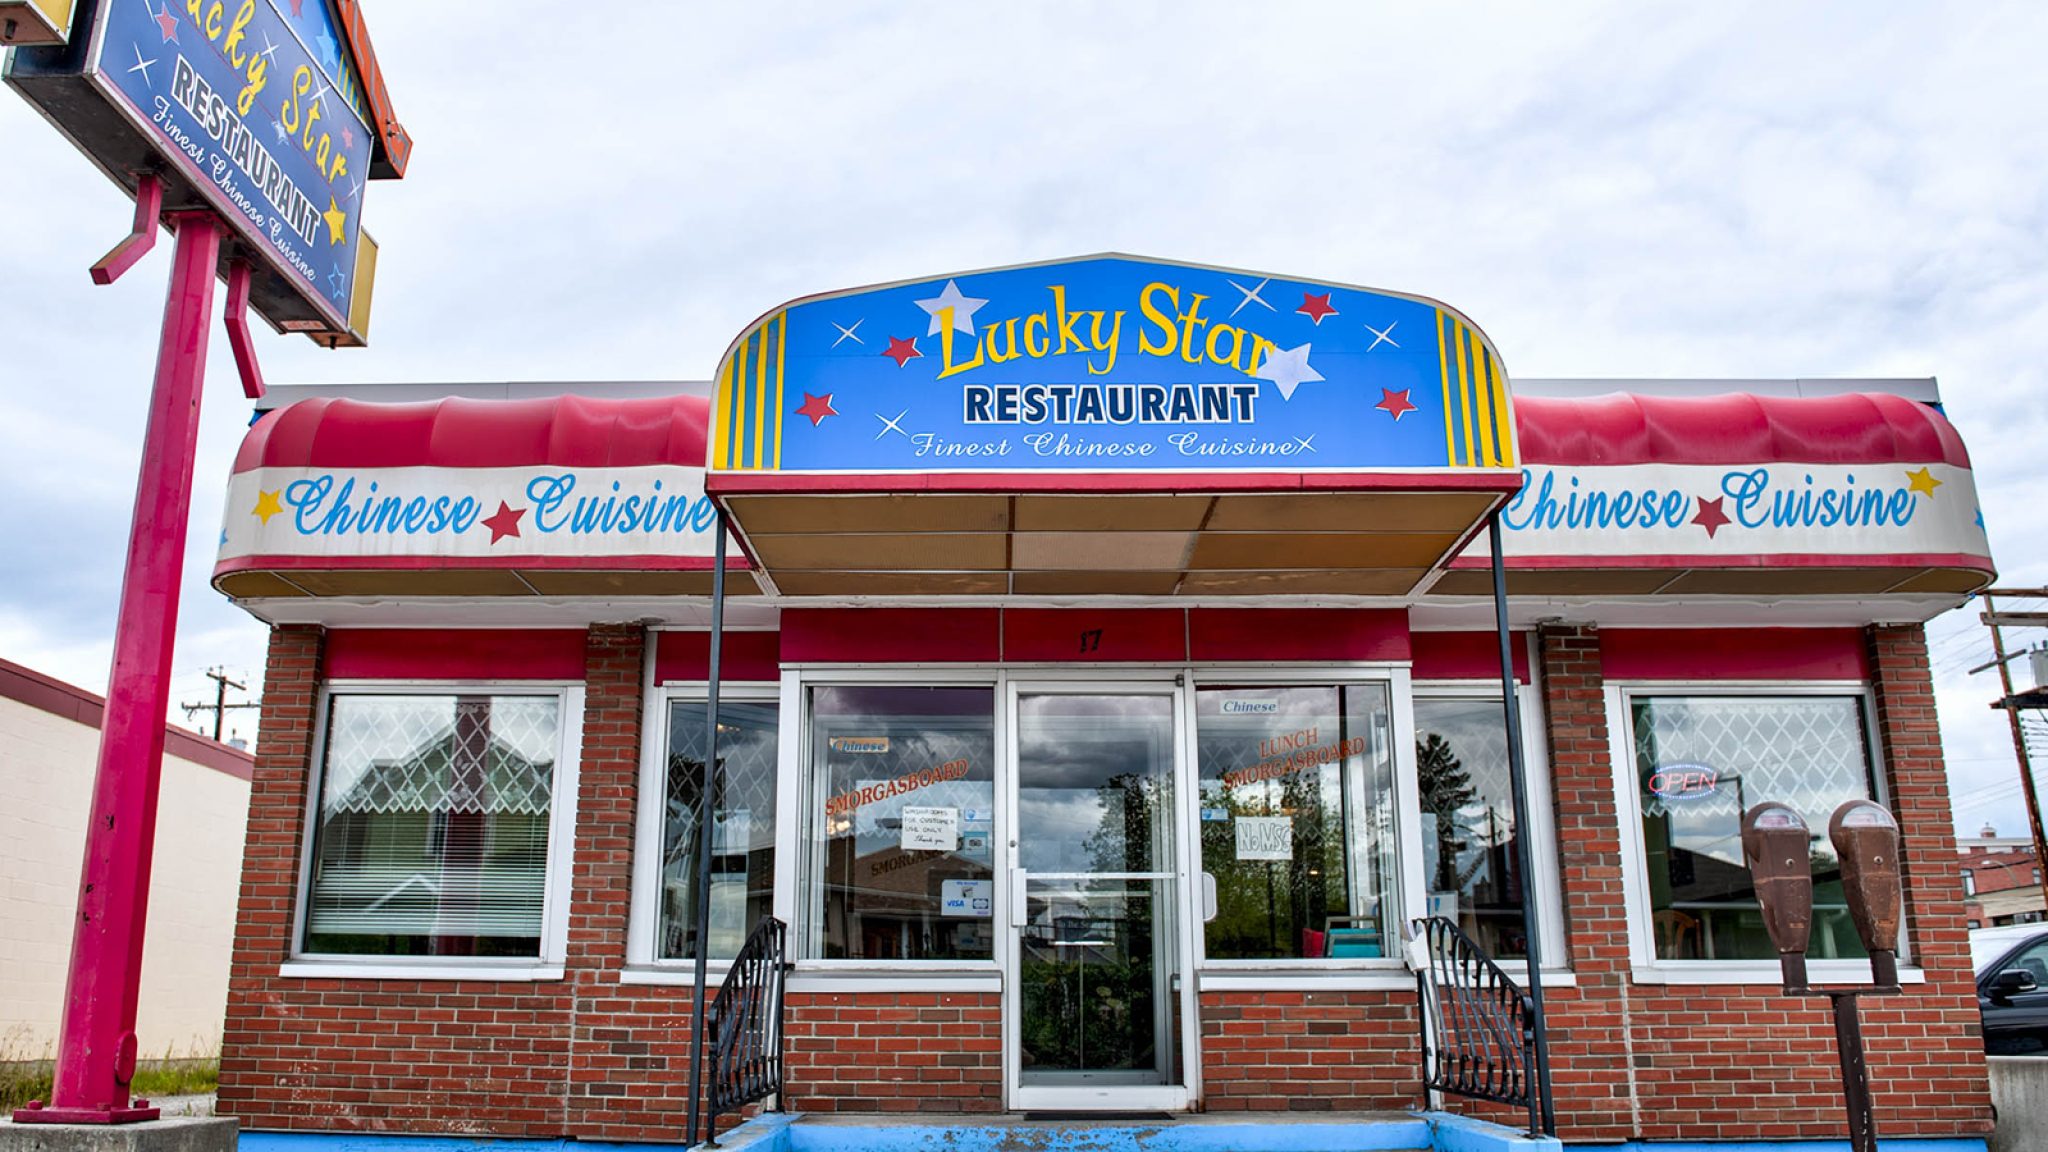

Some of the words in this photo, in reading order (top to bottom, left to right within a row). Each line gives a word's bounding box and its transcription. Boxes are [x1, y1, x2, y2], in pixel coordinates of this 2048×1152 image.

[187, 0, 267, 117] ucky
[282, 64, 347, 183] Star
[171, 53, 321, 247] RESTAURANT
[153, 94, 206, 165] Finest
[210, 153, 266, 229] Chinese
[269, 217, 316, 281] Cuisine
[936, 284, 1126, 380] Lucky
[1140, 282, 1277, 377] Star
[962, 383, 1259, 425] RESTAURANT
[911, 432, 1013, 458] Finest
[1022, 432, 1157, 457] Chinese
[1168, 432, 1299, 458] Cuisine
[286, 475, 482, 536] Chinese
[526, 474, 718, 535] Cuisine
[1500, 467, 1691, 531] Chinese
[1721, 468, 1919, 529] Cuisine
[1080, 628, 1103, 654] 17
[1222, 701, 1277, 713] Chinese
[831, 738, 886, 752] Chinese
[1222, 736, 1366, 792] SMORGASBOARD
[1259, 726, 1319, 759] LUNCH
[824, 758, 969, 817] SMORGASBOARD
[1648, 772, 1717, 792] OPEN
